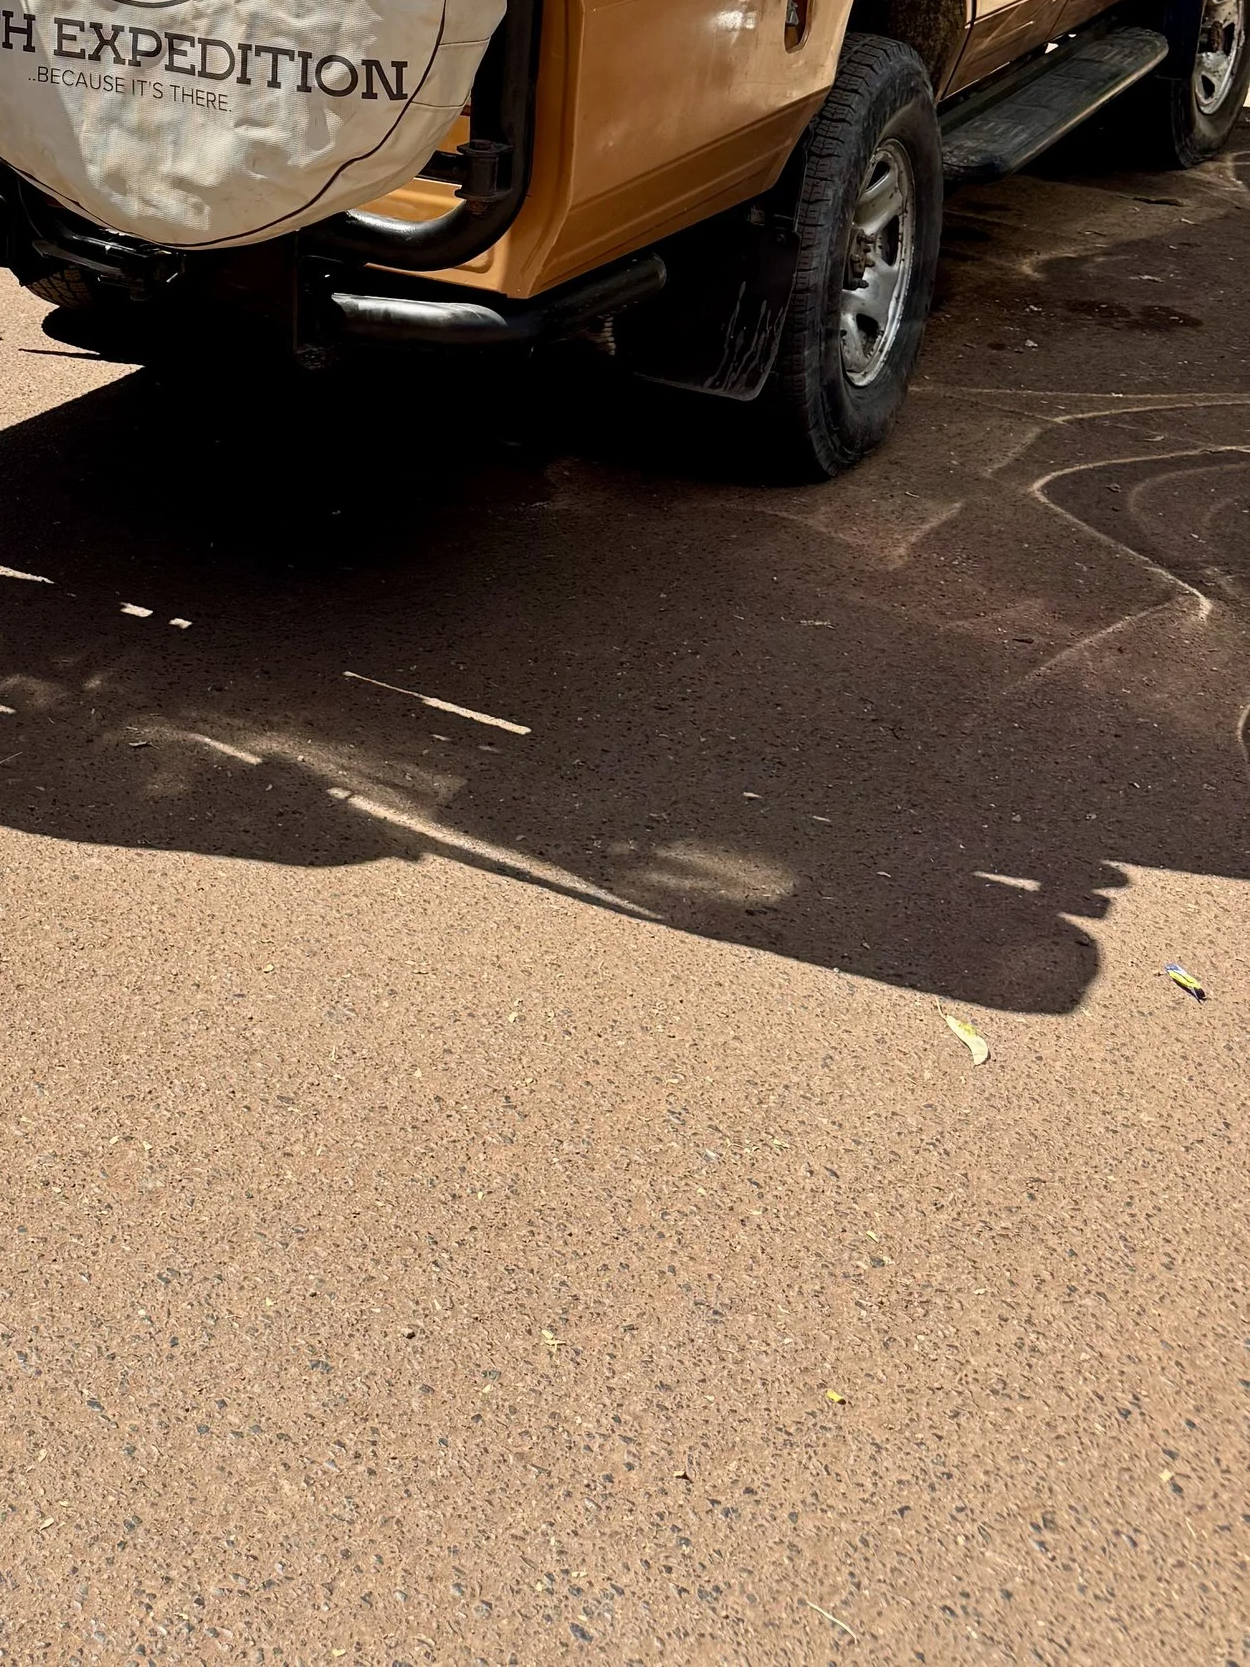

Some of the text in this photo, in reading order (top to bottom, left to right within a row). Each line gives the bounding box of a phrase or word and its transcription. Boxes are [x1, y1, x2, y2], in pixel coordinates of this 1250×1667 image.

[53, 16, 409, 101] EXPEDITION
[131, 78, 164, 99] IT'S
[169, 84, 232, 112] THERE.
